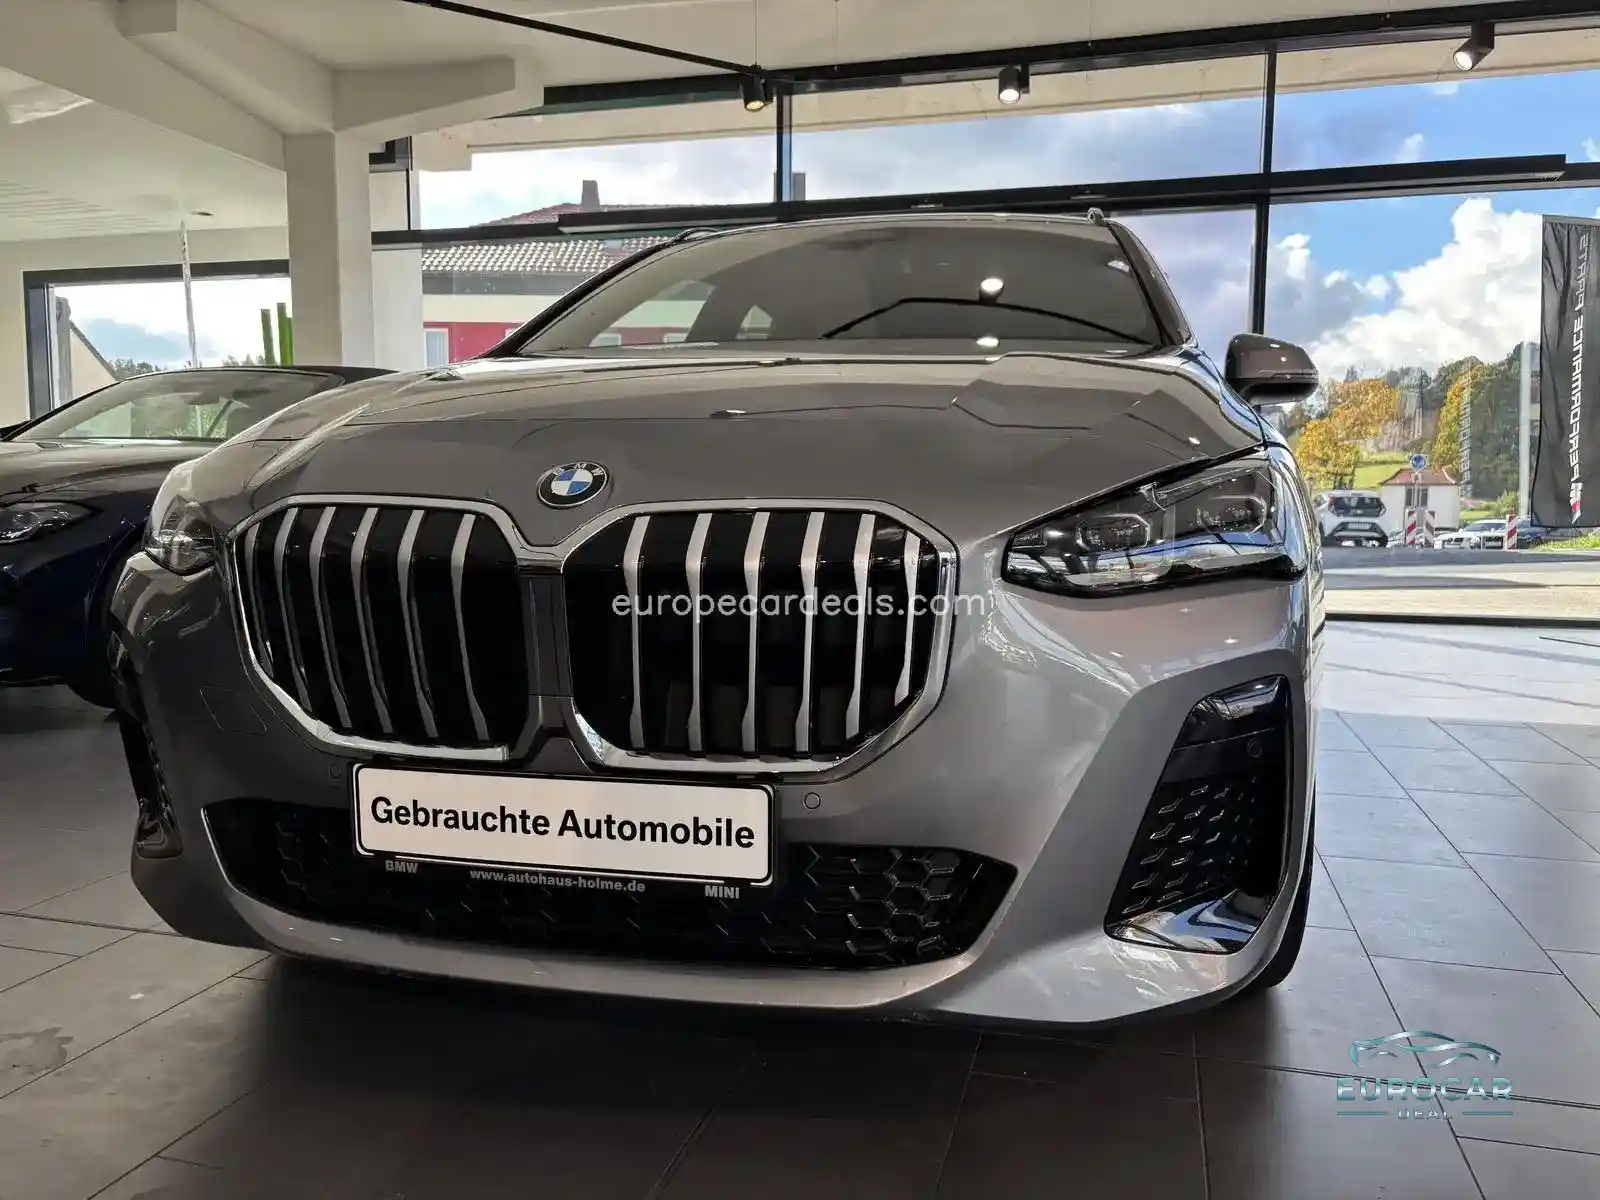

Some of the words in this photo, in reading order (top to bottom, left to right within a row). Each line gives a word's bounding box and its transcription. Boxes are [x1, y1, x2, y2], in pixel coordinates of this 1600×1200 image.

[370, 796, 550, 836] Gebrauchte
[557, 808, 756, 848] Automobile
[385, 860, 418, 874] BMW
[469, 869, 646, 892] www.autohaus-holme.de
[704, 884, 740, 899] MINI
